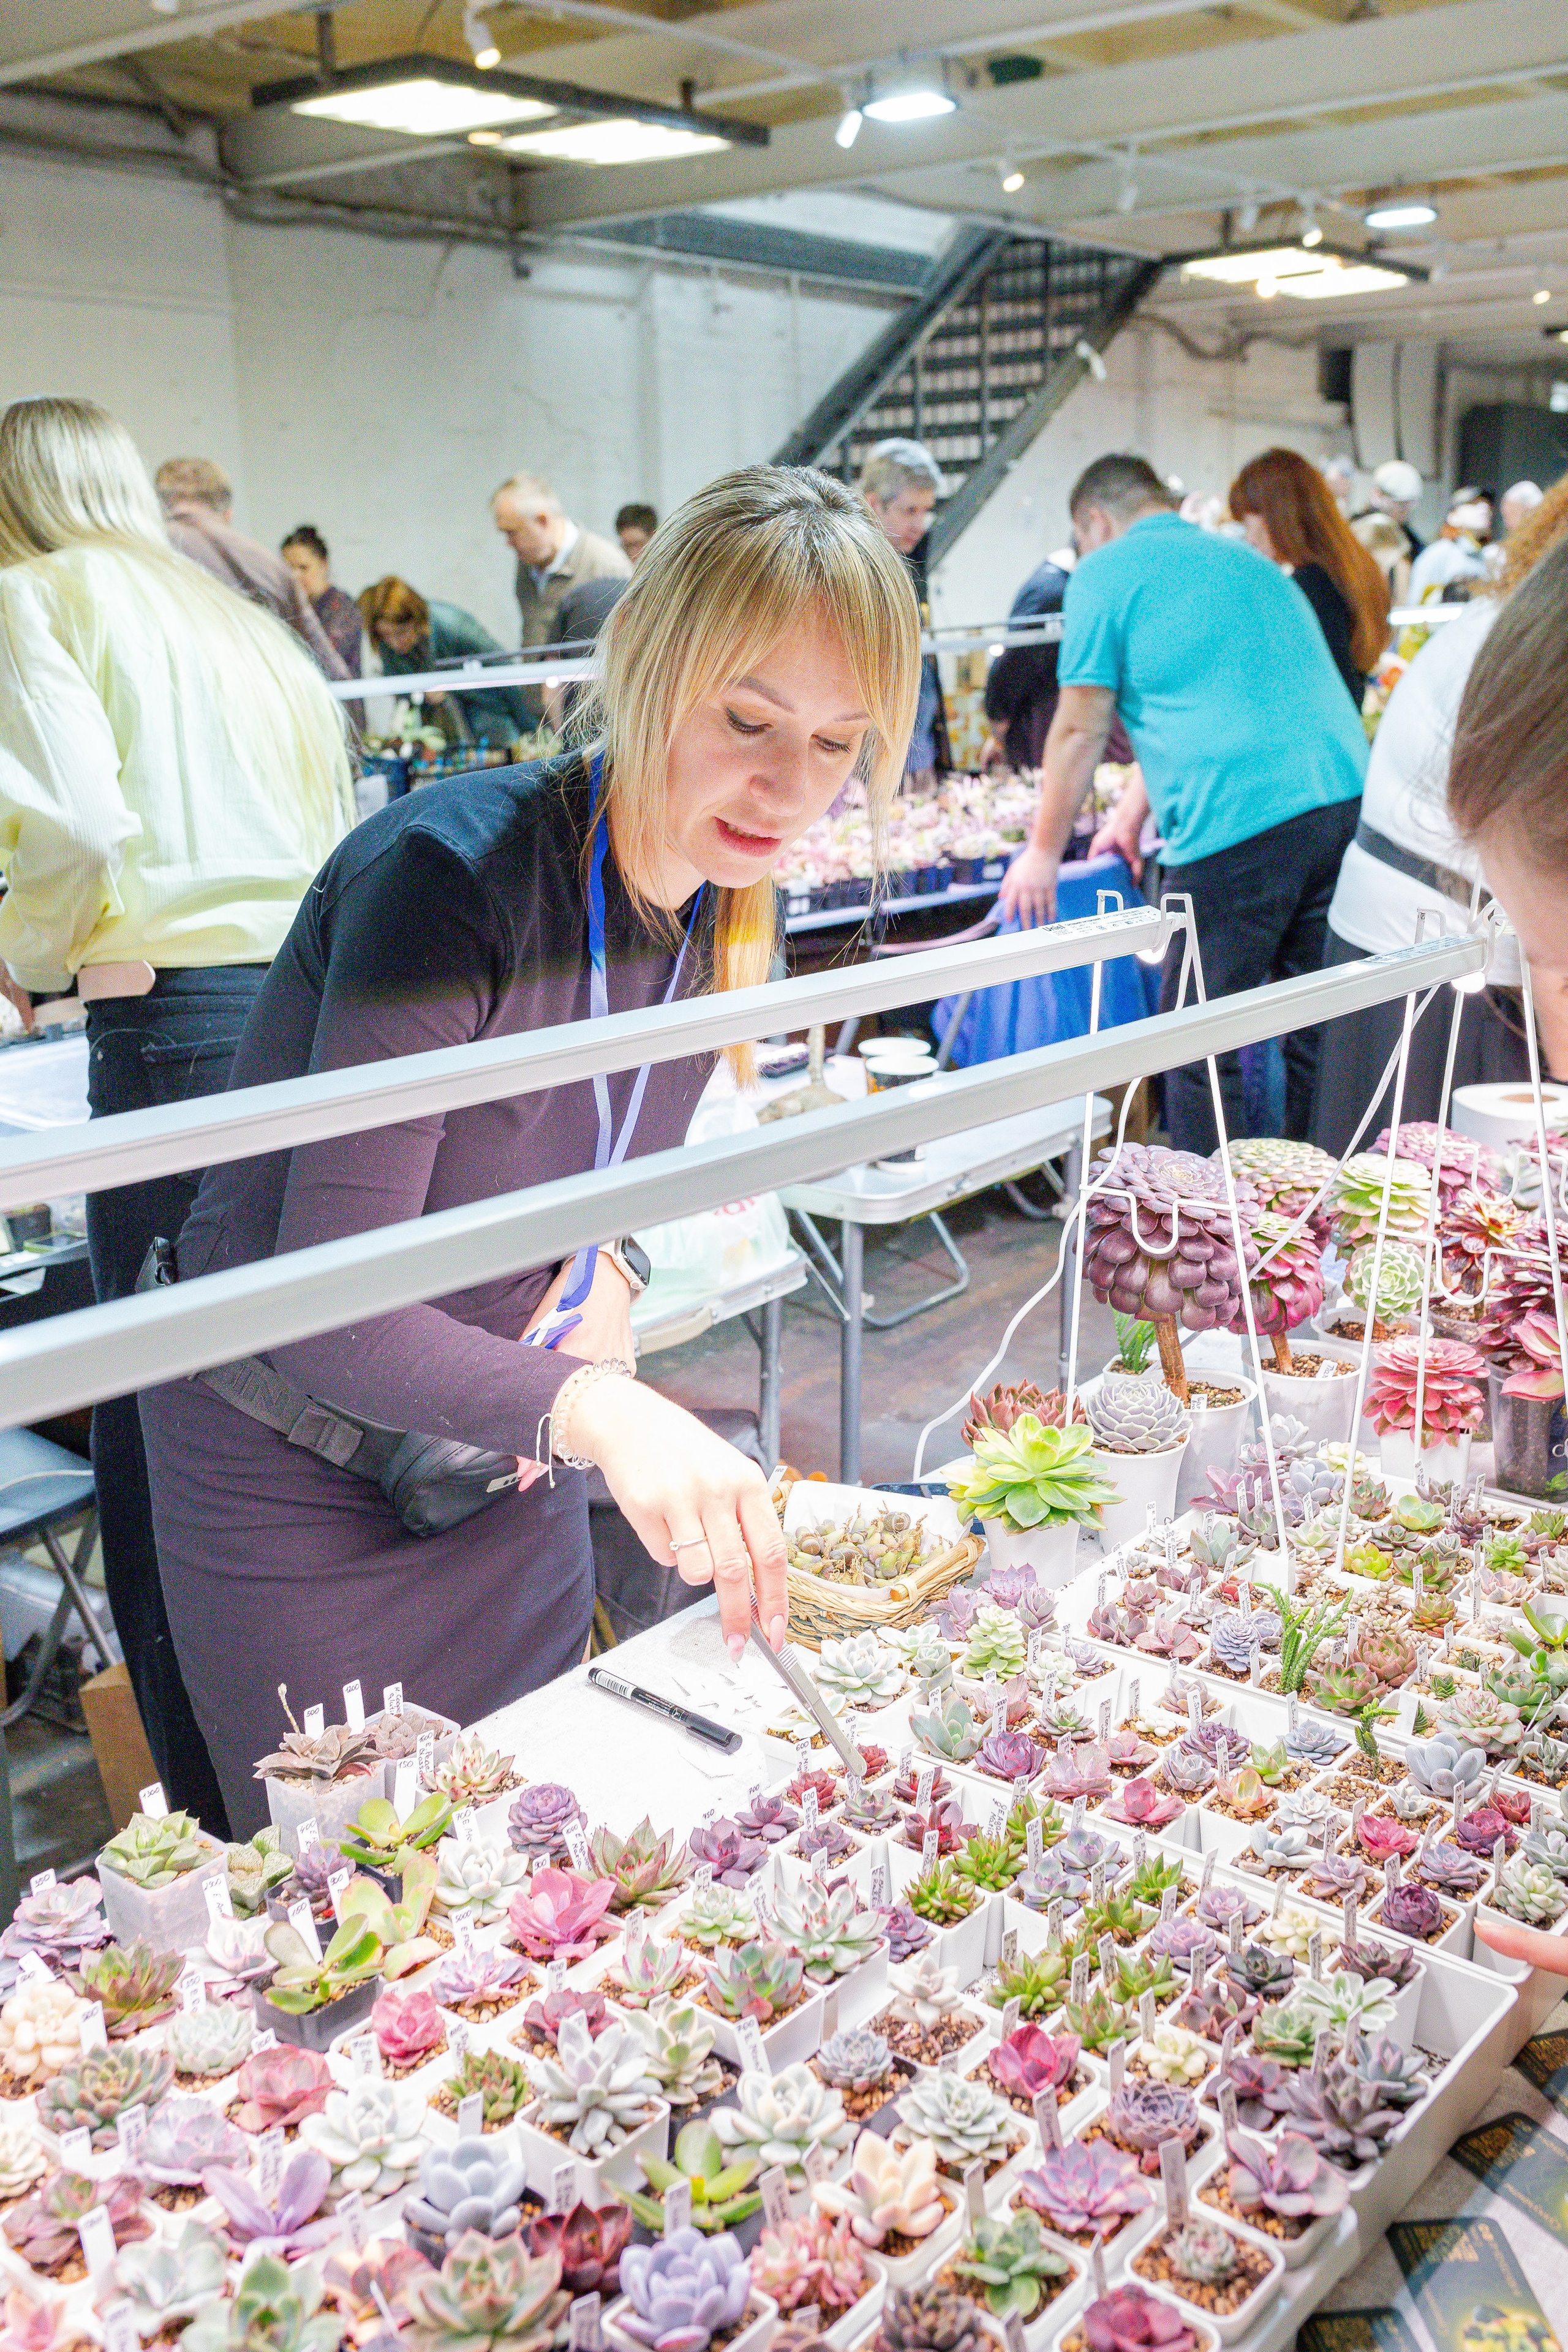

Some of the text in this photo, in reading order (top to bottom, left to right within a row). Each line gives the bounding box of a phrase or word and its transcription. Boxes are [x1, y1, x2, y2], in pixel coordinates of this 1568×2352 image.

[1042, 924, 1066, 932] Uniel
[344, 1683, 360, 1694] 1200
[306, 1707, 320, 1718] 500
[796, 1741, 809, 1752] 600
[398, 1760, 414, 1769] 150
[141, 1787, 160, 1800] 1300
[748, 1784, 760, 1795] 700
[803, 1791, 815, 1803] 600
